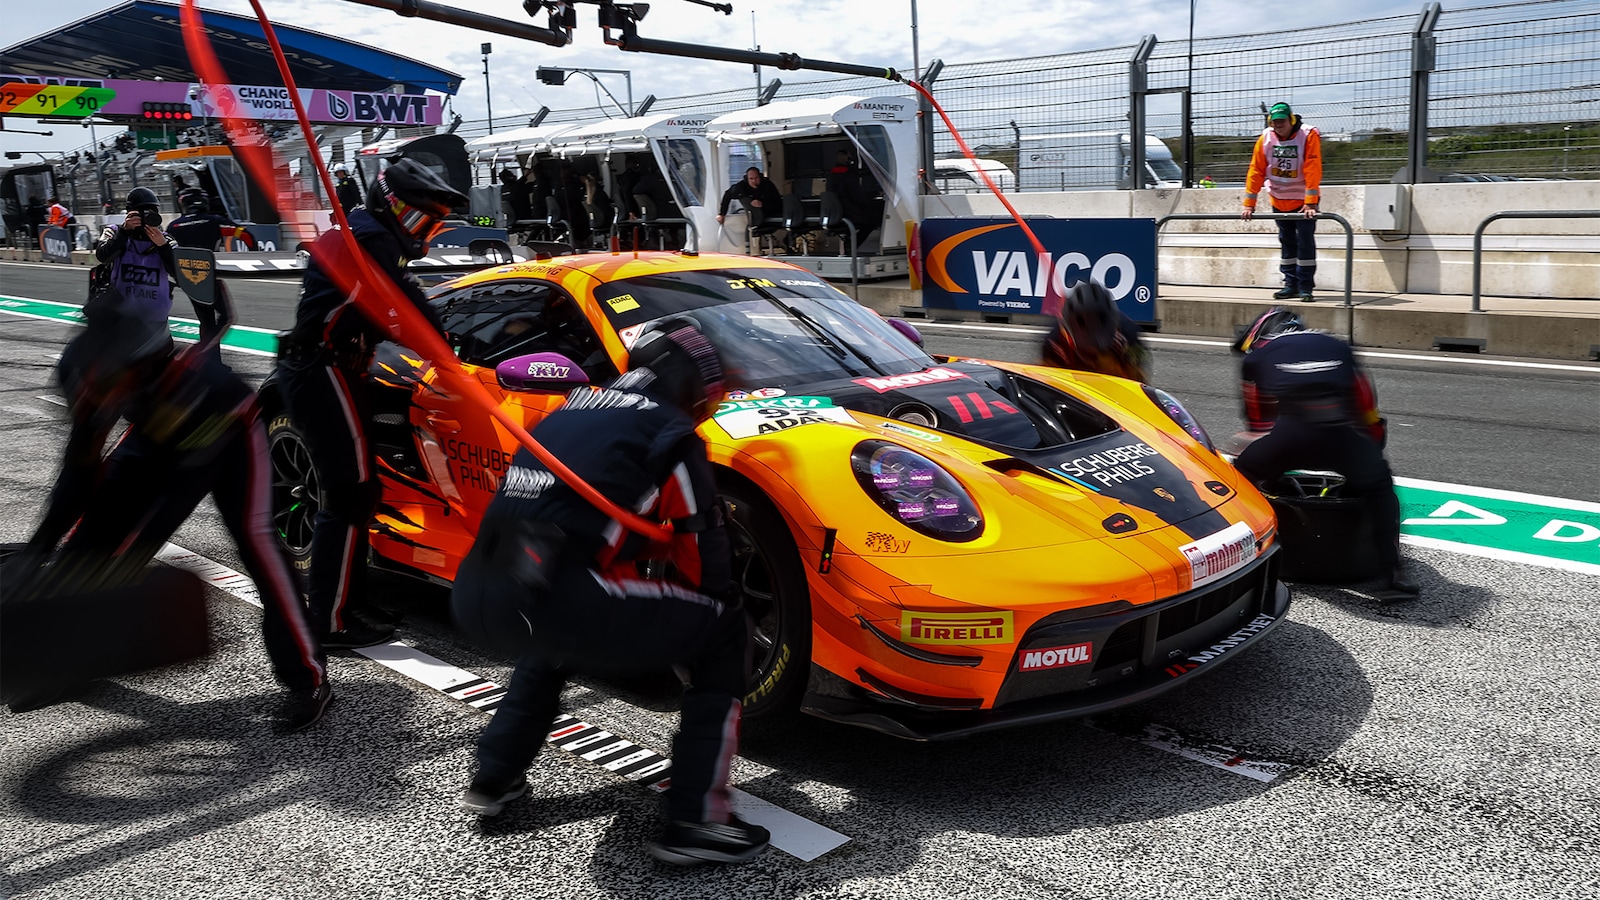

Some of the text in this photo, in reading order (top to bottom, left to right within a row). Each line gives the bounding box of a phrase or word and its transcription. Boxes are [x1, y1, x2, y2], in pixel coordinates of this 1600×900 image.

[36, 94, 58, 108] 91
[75, 97, 98, 110] 90
[239, 87, 292, 99] CHANG
[354, 94, 427, 122] BWT
[863, 103, 904, 111] MANTHEY
[512, 265, 562, 276] SCHURING
[971, 250, 1136, 302] VAICO
[610, 295, 632, 306] ADAC
[534, 366, 570, 378] KW
[866, 367, 964, 390] MOTUL
[448, 439, 514, 473] SCHUBE
[1060, 443, 1159, 478] SCHUBERG
[460, 466, 503, 494] PHILI
[1092, 460, 1155, 488] PHILIS
[911, 617, 1005, 640] PIRELLI
[1188, 612, 1276, 663] MANTHEY
[1022, 645, 1090, 668] MOTUL
[743, 643, 791, 707] PIRELLI
